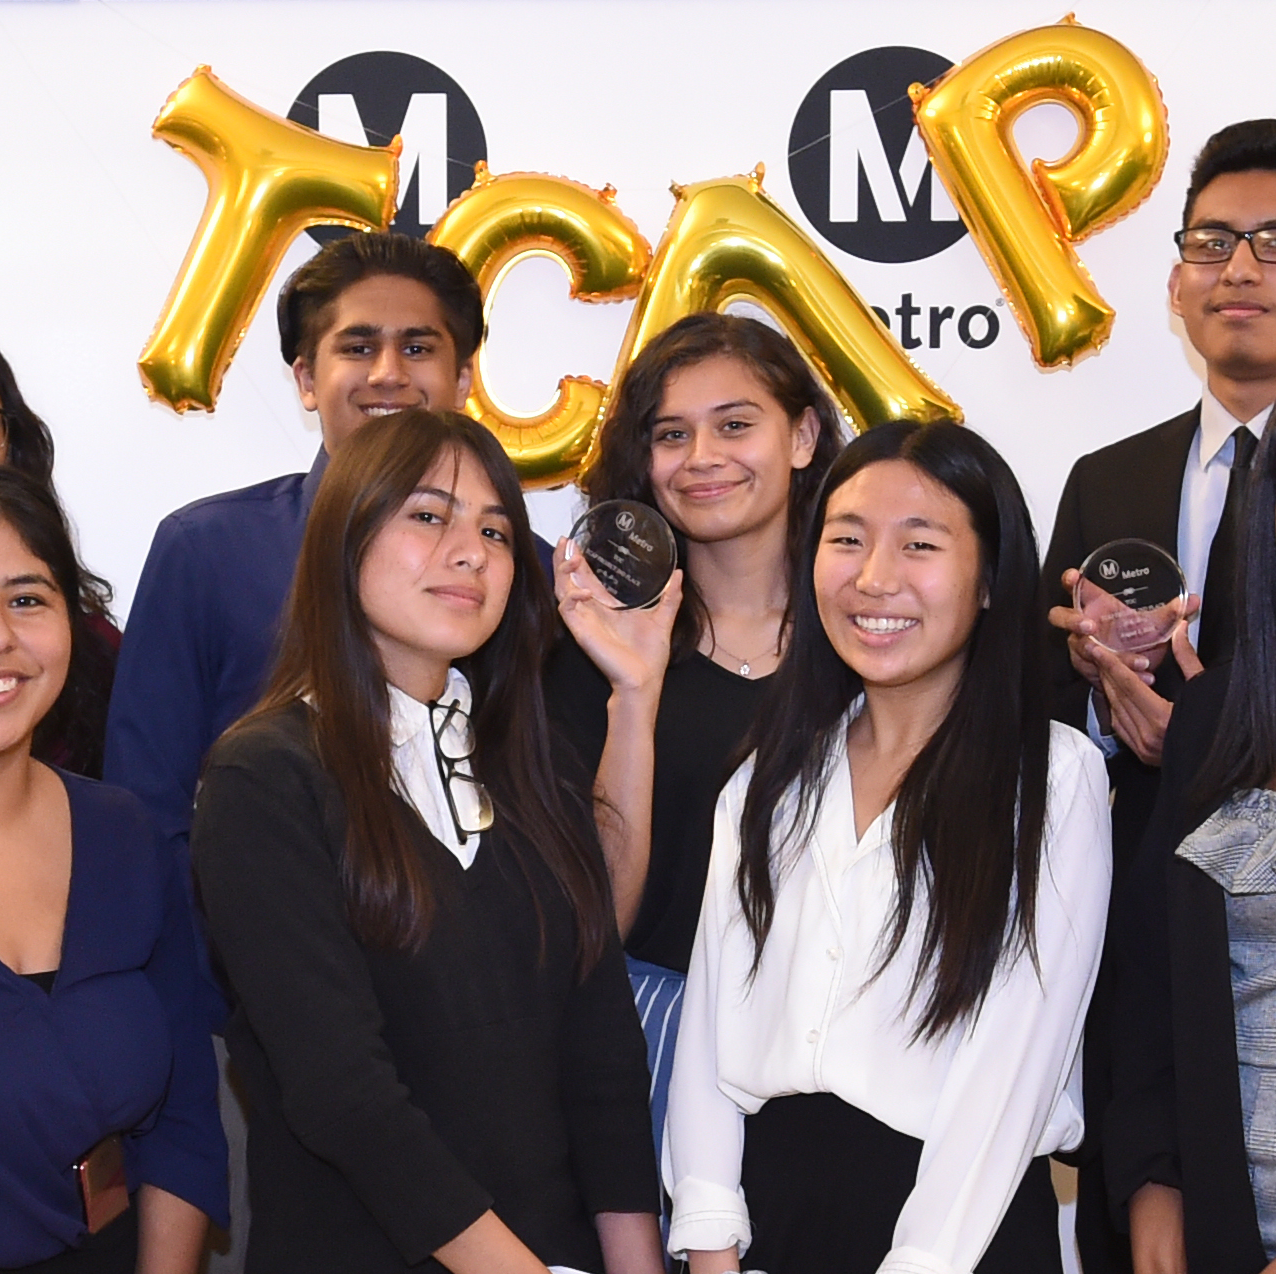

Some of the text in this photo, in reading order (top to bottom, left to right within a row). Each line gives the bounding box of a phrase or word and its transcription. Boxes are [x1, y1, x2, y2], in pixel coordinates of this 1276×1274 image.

[830, 90, 959, 222] M
[629, 532, 653, 552] Metro
[1122, 567, 1150, 579] Metro
